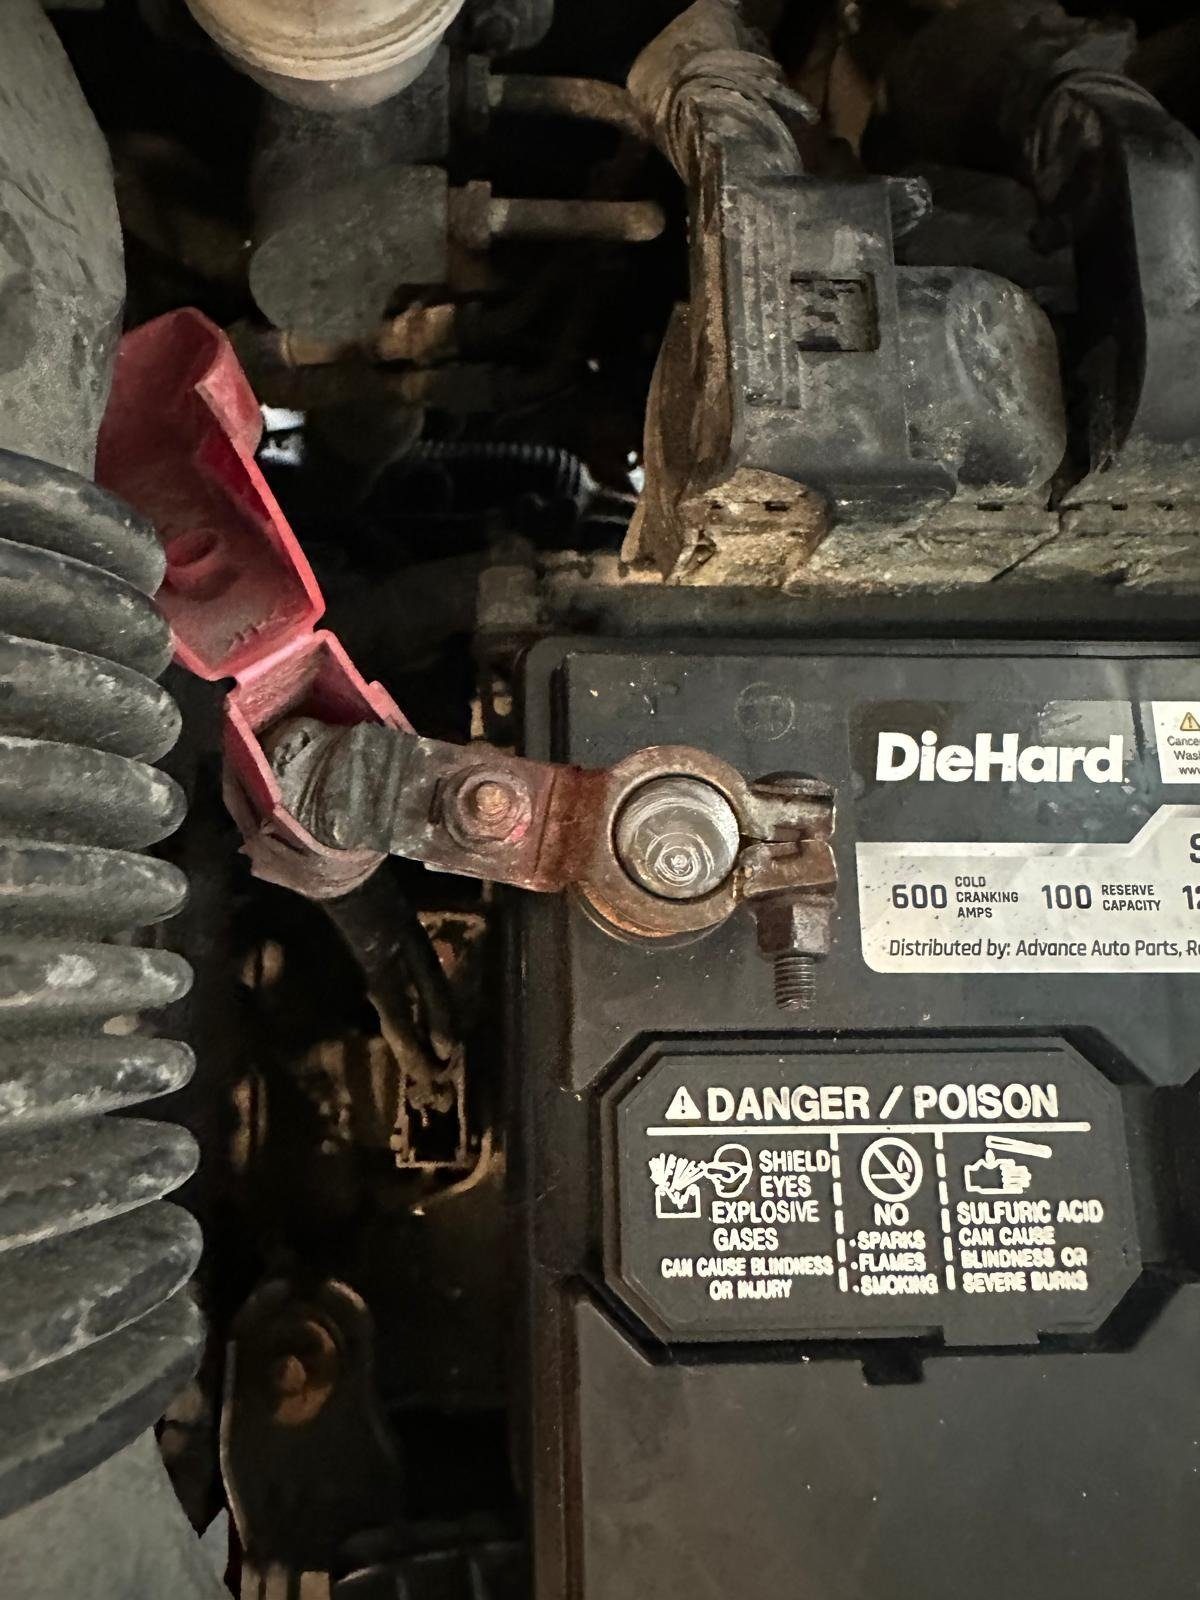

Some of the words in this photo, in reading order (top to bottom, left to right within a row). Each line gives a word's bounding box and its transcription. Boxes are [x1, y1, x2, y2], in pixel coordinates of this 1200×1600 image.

[876, 730, 1125, 783] DieHard
[955, 876, 986, 888] COLD
[1101, 884, 1155, 897] RESERVE
[892, 884, 948, 910] 600
[956, 891, 1019, 904] CRANKING
[1041, 884, 1093, 910] 100
[1102, 899, 1161, 912] CAPACITY
[957, 907, 993, 919] AMPS
[889, 939, 981, 957] Distributed
[987, 941, 1011, 960] by:
[1016, 939, 1087, 957] Advance
[1091, 940, 1129, 957] Auto
[1135, 940, 1182, 958] Parts,
[1187, 939, 1200, 957] R
[707, 1086, 870, 1122] DANGER
[914, 1083, 1059, 1119] POISON
[758, 1149, 831, 1174] SHIELD
[760, 1174, 812, 1198] EYES
[711, 1200, 820, 1224] EXPLOSIVE
[873, 1202, 910, 1227] NO
[956, 1200, 1052, 1226] SULFURIC
[1057, 1199, 1104, 1224] ACID
[713, 1227, 779, 1252] GASES
[856, 1229, 927, 1251] SPARKS
[958, 1227, 995, 1247] CAN
[999, 1225, 1056, 1246] CAUSE
[661, 1257, 693, 1278] CAN
[696, 1257, 747, 1278] CAUSE
[750, 1255, 834, 1276] BLINDNESS
[858, 1252, 927, 1273] FLAMES
[960, 1248, 1056, 1269] BLINDNESS
[1060, 1246, 1088, 1267] OR
[709, 1279, 734, 1301] OR
[737, 1278, 793, 1299] INJURY
[962, 1271, 1027, 1293] SEVERE
[1030, 1269, 1089, 1292] BURNS
